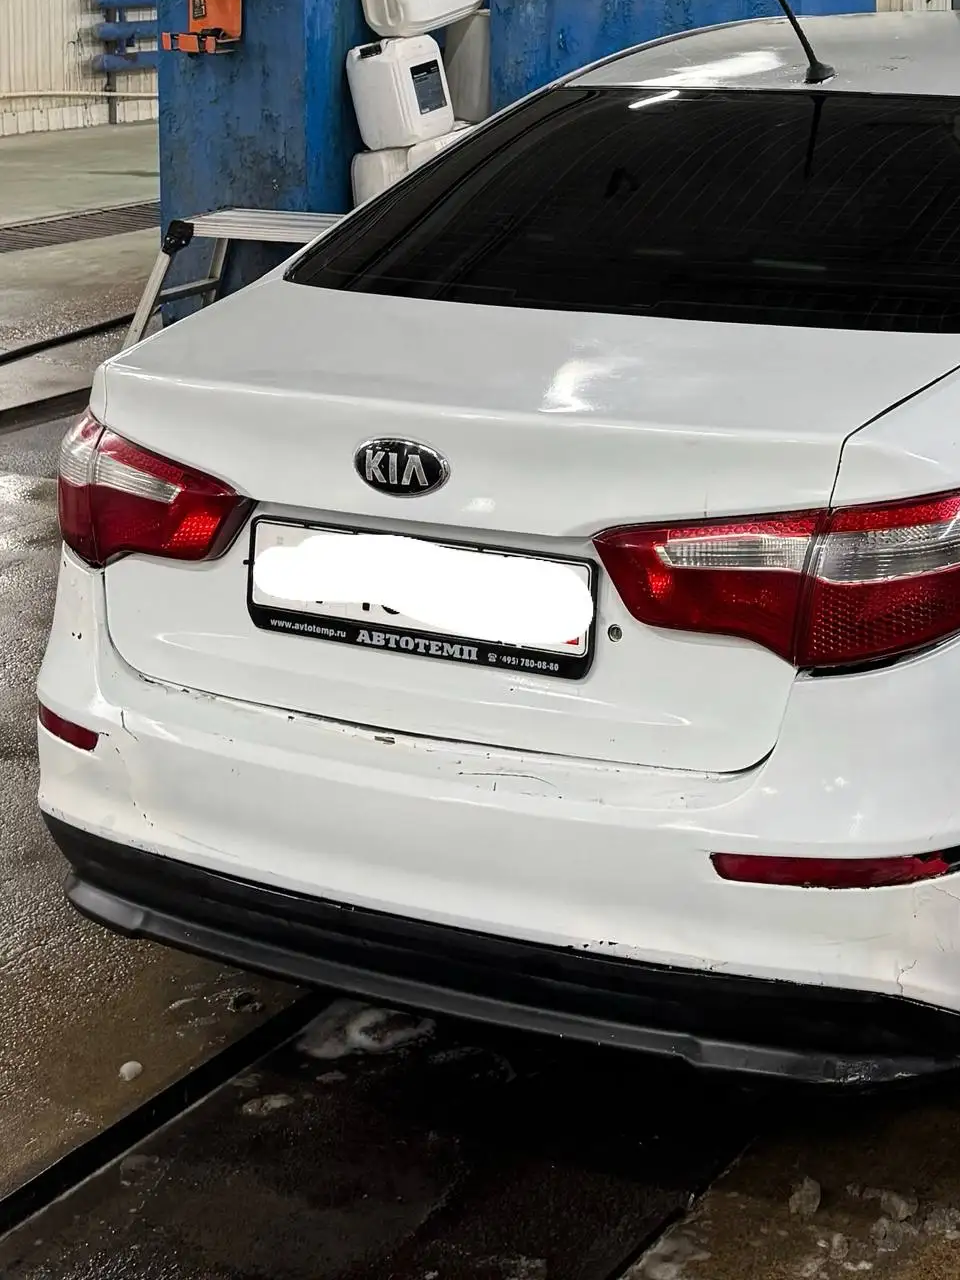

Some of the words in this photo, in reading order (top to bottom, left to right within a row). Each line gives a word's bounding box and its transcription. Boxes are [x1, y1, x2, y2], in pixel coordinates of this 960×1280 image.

[365, 449, 429, 486] KIA
[270, 618, 347, 638] www.avtotemp.ru
[356, 629, 479, 661] АВТОТЕМП
